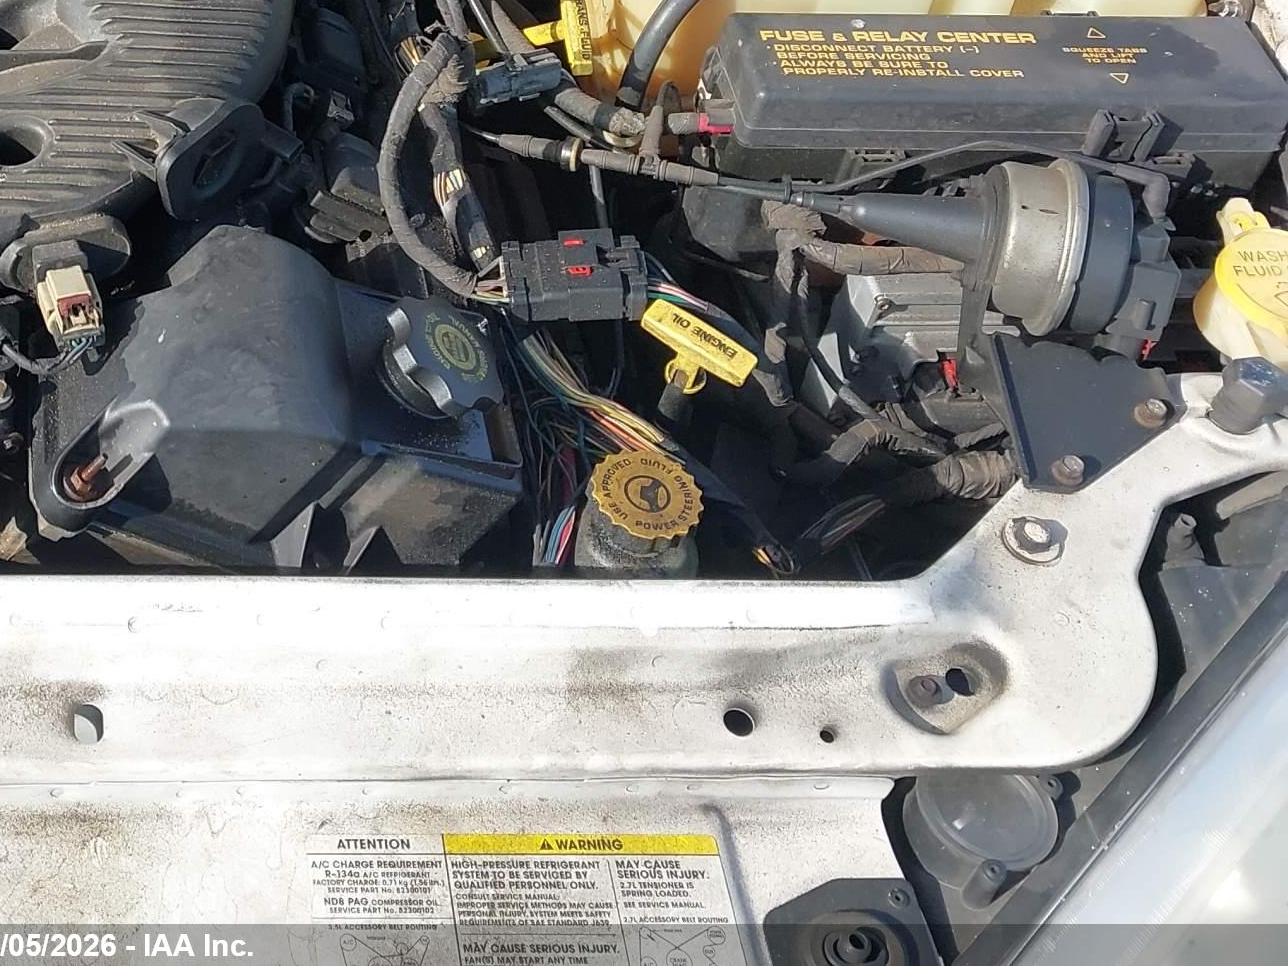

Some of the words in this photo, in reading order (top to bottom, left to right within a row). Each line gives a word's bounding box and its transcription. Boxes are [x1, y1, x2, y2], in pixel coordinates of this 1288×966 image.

[759, 30, 826, 42] FUSE
[832, 33, 847, 42] &
[852, 31, 929, 43] RELAY
[937, 32, 1037, 44] CENTER
[774, 44, 877, 53] DISCONNECT
[883, 45, 953, 53] BATTERY
[776, 52, 840, 60] BEFORE
[844, 52, 931, 61] SERVICING
[780, 60, 847, 68] ALWAYS
[854, 60, 873, 68] BE
[879, 61, 922, 69] SURE
[929, 61, 949, 69] TO
[783, 67, 866, 76] PROPERLY
[872, 68, 965, 77] RE-INSTALL
[970, 69, 1025, 78] COVER
[1233, 265, 1282, 277] FLUID
[672, 313, 691, 329] OIL
[691, 327, 738, 361] ENGINE
[640, 458, 674, 475] FLUID
[602, 458, 632, 499] APPROVED
[673, 475, 694, 522] STEERING
[608, 501, 629, 520] USE
[635, 519, 680, 531] POWER
[337, 838, 410, 850] ATTENTION
[555, 839, 623, 851] WARNING
[311, 860, 329, 869] A/C
[332, 860, 374, 869] CHARGE
[376, 860, 442, 869] REQUIREMENT
[451, 860, 532, 869] HIGH-PRESSURE
[533, 860, 600, 869] REFRIGERANT
[615, 860, 640, 870] MAY
[643, 860, 681, 870] CAUSE
[325, 870, 360, 878] R-134a
[452, 870, 490, 879] SYSTEM
[492, 870, 506, 879] TO
[509, 870, 521, 879] BE
[523, 870, 572, 879] SERVICED
[575, 870, 588, 879] BY
[617, 870, 664, 880] SERIOUS
[667, 870, 710, 880] INJURY.
[399, 879, 408, 887] kg
[454, 881, 506, 890] QUALIFIED
[509, 881, 567, 890] PERSONNEL
[570, 881, 599, 890] ONLY.
[324, 897, 344, 906] ND8
[348, 897, 369, 906] PAG
[458, 910, 496, 918] PERSONAL
[530, 910, 558, 918] SYSTEM
[559, 910, 583, 918] MEETS
[584, 910, 611, 918] SAFETY
[463, 943, 487, 954] MAY
[490, 943, 527, 954] CAUSE
[529, 943, 575, 954] SERIOUS
[578, 943, 620, 954] INJURY.
[497, 956, 517, 964] MAY
[519, 956, 545, 964] START
[547, 956, 565, 964] ANY
[568, 956, 588, 964] TIME
